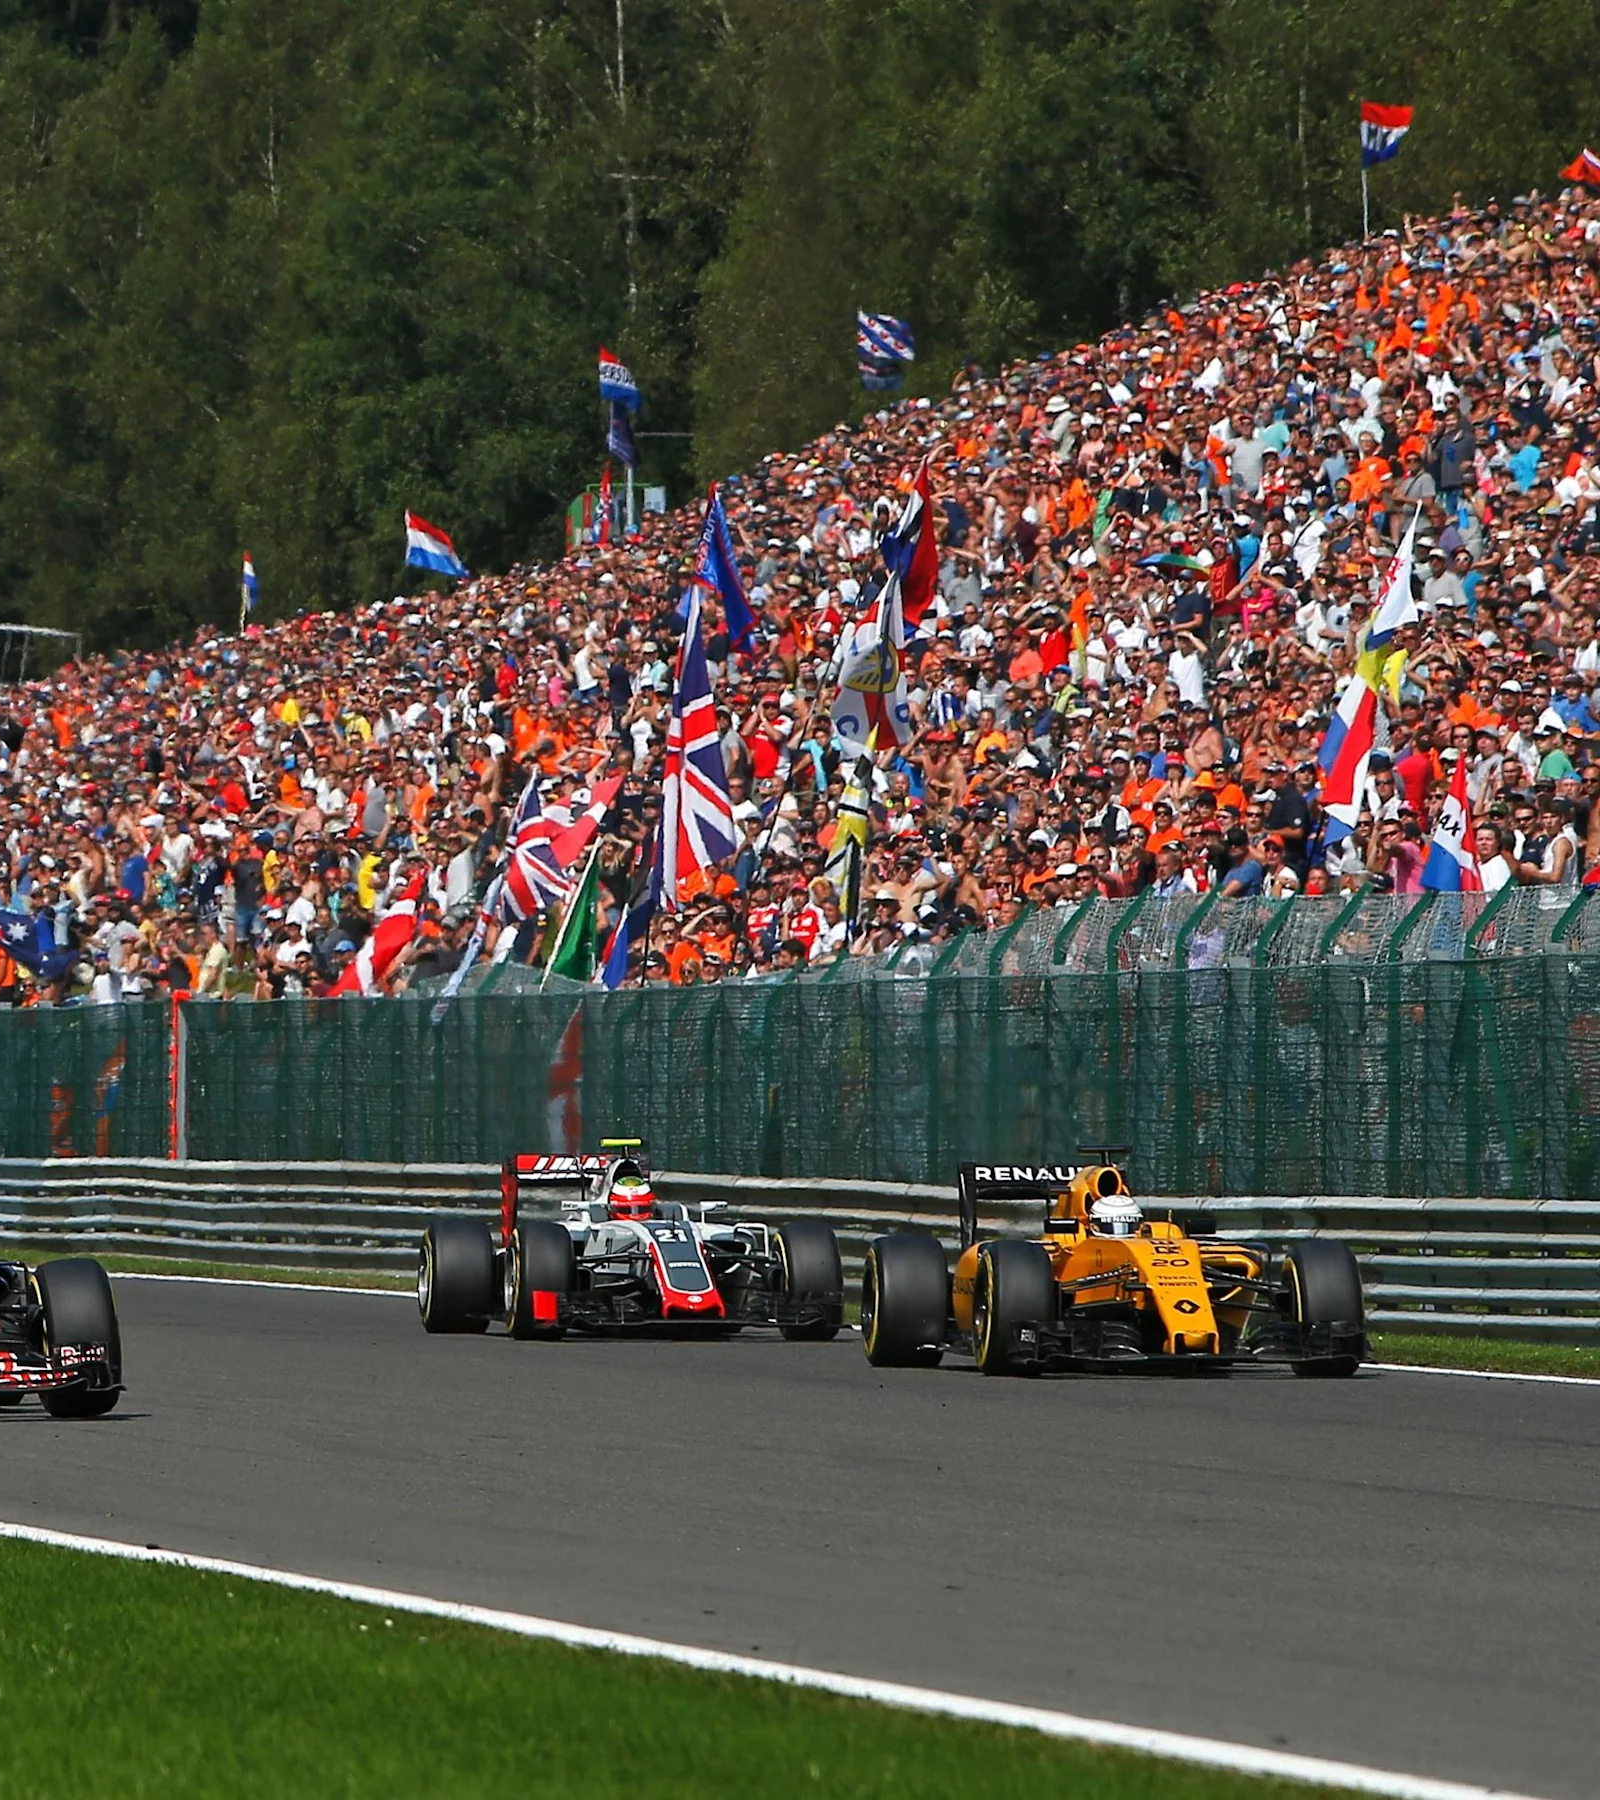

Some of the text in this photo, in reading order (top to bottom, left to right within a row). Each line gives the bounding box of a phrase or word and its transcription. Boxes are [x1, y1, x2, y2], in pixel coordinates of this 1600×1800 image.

[974, 1167, 1078, 1182] RENAU
[654, 1229, 688, 1242] 21
[1151, 1258, 1190, 1267] 20
